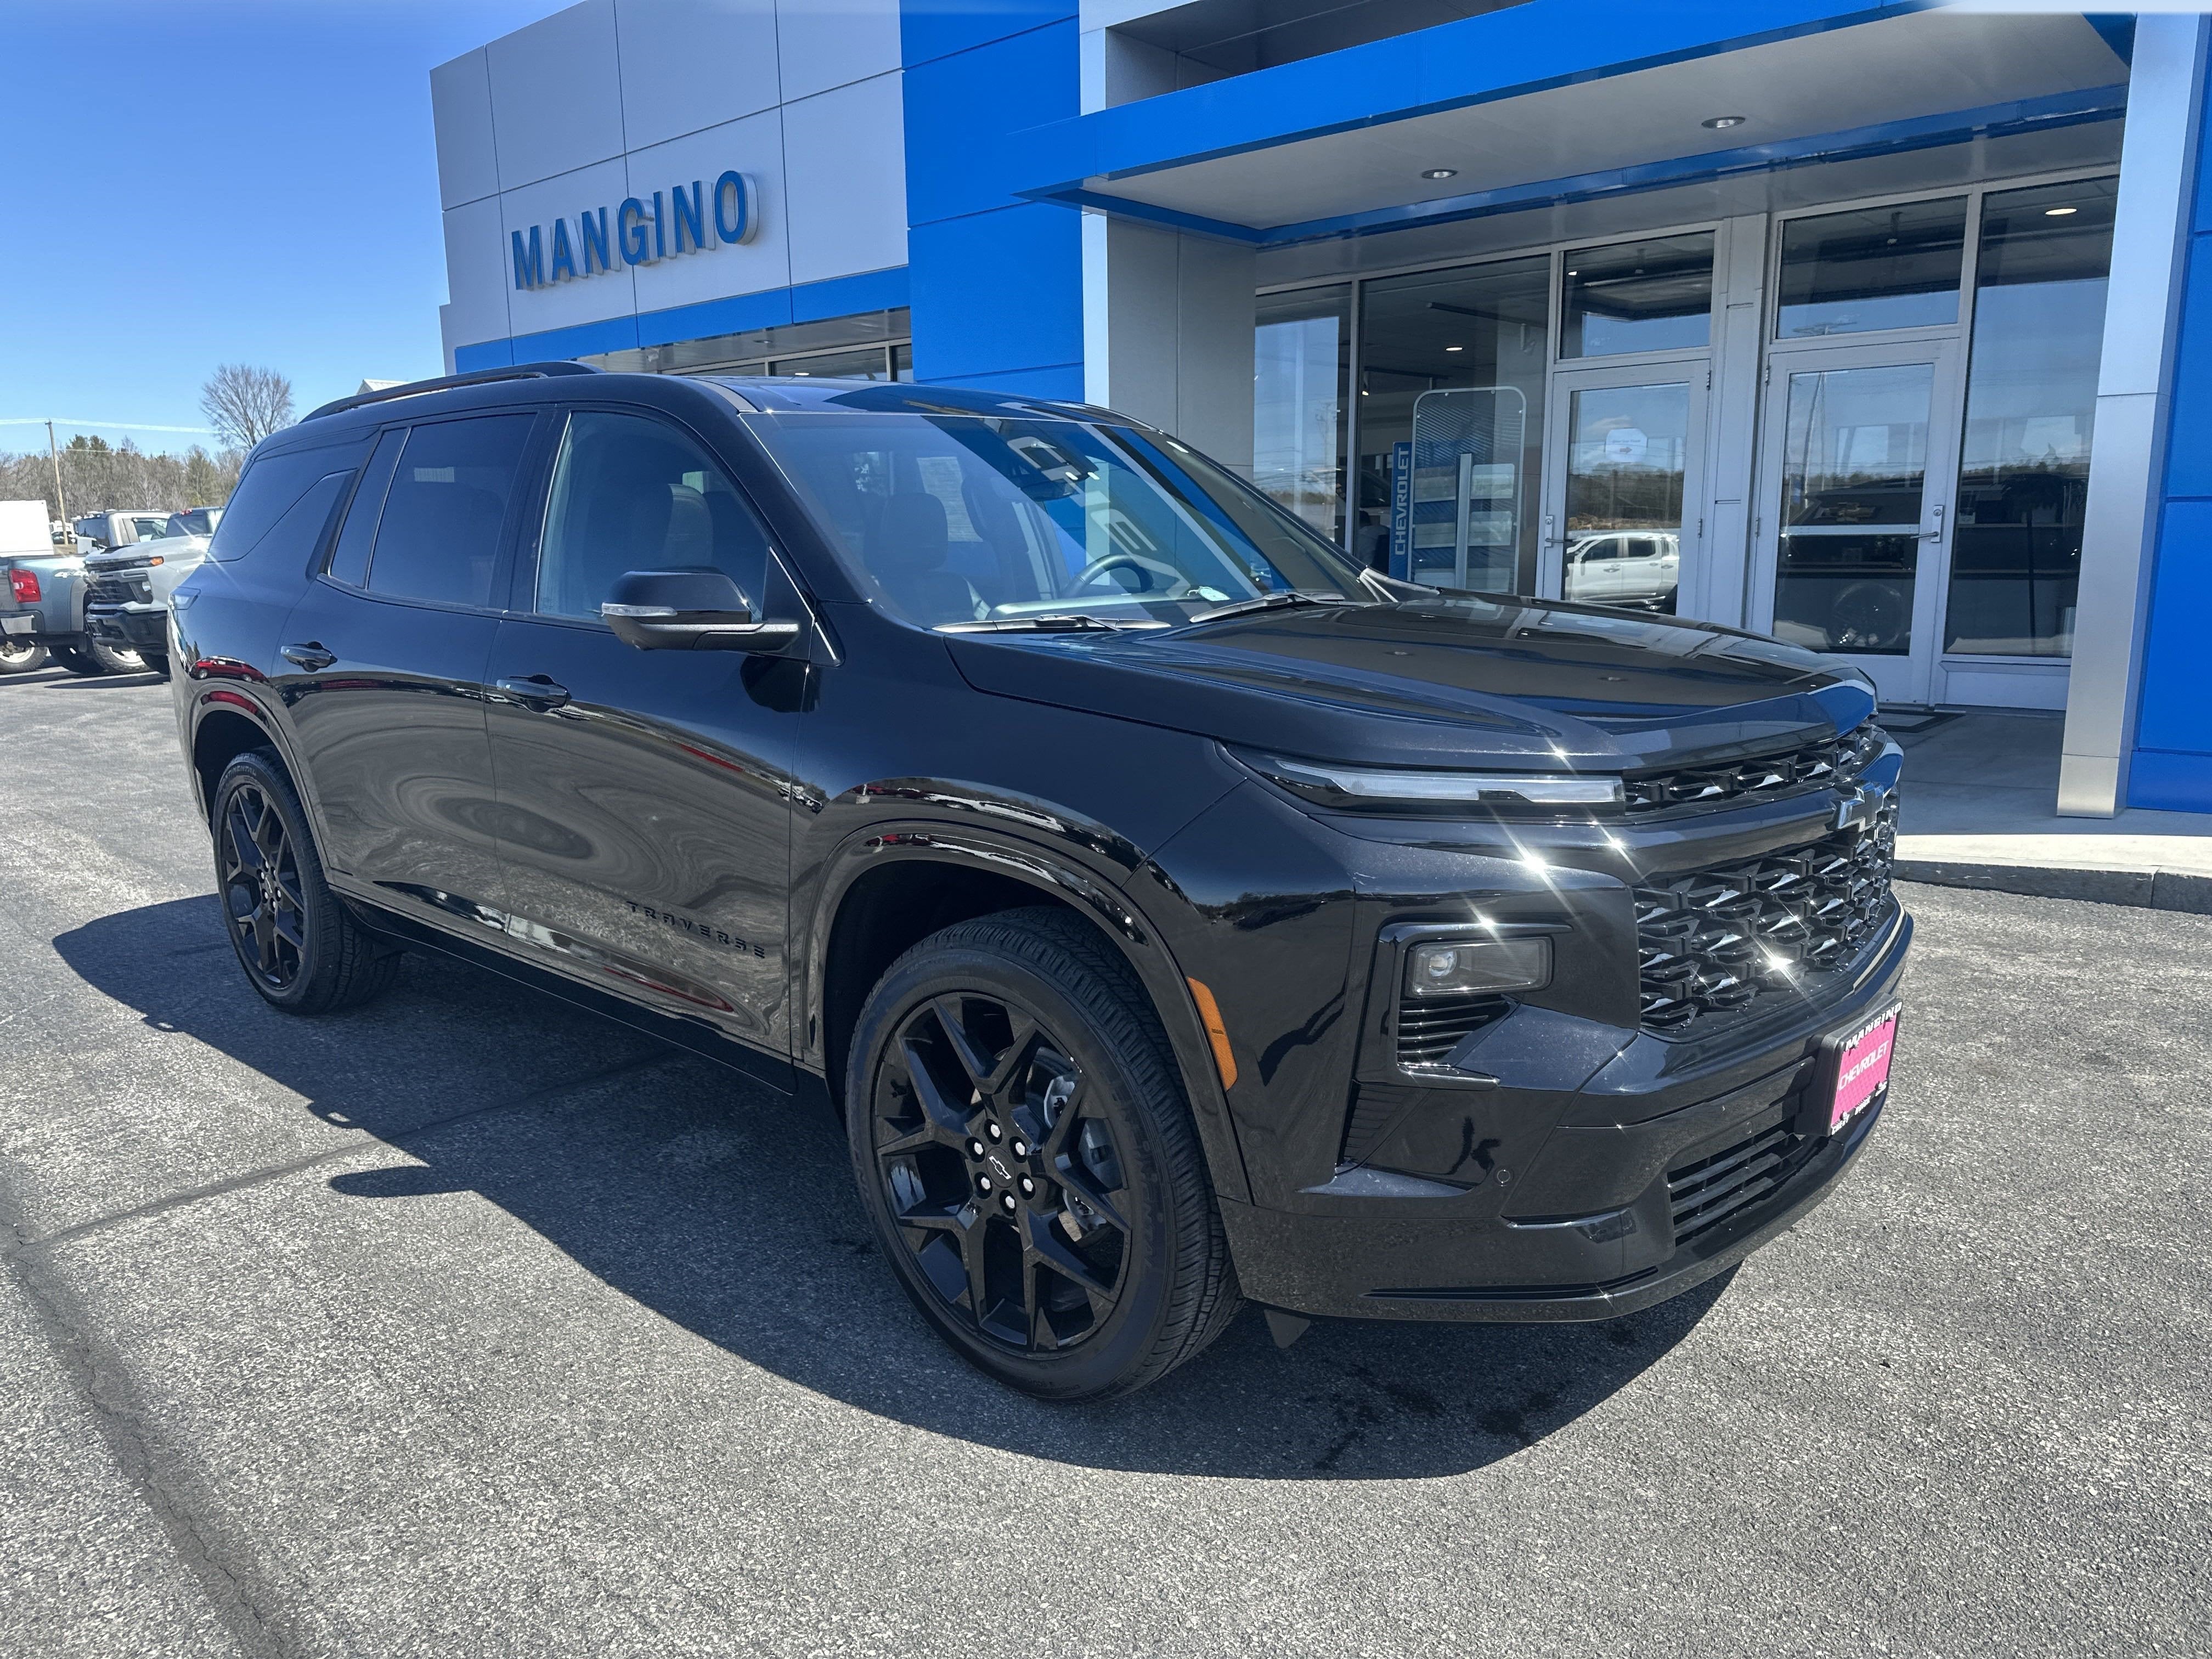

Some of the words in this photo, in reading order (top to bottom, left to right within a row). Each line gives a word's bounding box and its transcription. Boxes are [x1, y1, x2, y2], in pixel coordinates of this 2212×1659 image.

[511, 170, 759, 290] MANGINO
[1395, 447, 1409, 555] CHEVROLET
[626, 901, 765, 959] TRAVERSE
[1845, 1002, 1903, 1052] MANGINO
[1838, 1040, 1889, 1091] CHEVROLET
